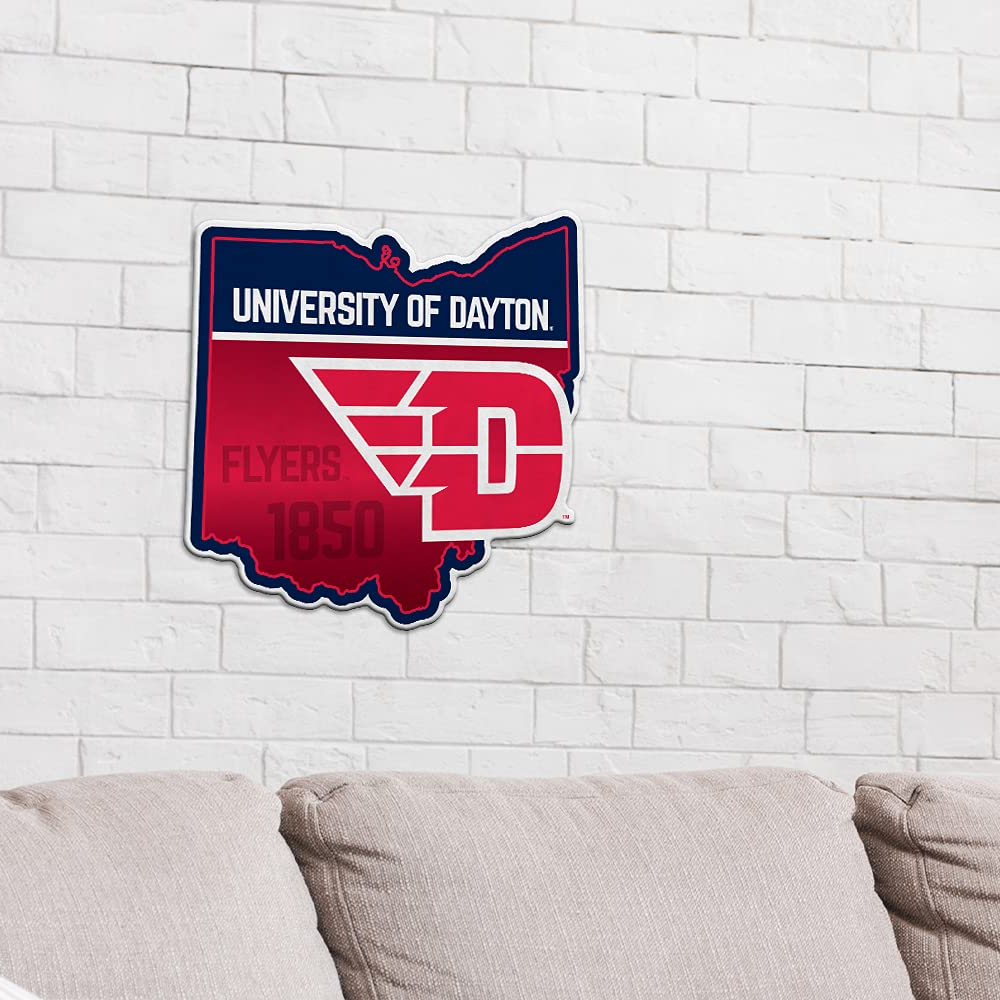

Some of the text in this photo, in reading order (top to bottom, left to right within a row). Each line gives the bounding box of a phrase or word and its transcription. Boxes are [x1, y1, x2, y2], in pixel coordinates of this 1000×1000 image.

[232, 287, 400, 327] UNIVERSITY
[407, 295, 440, 327] OF
[222, 445, 341, 483] FLYERS
[267, 500, 384, 561] 1850
